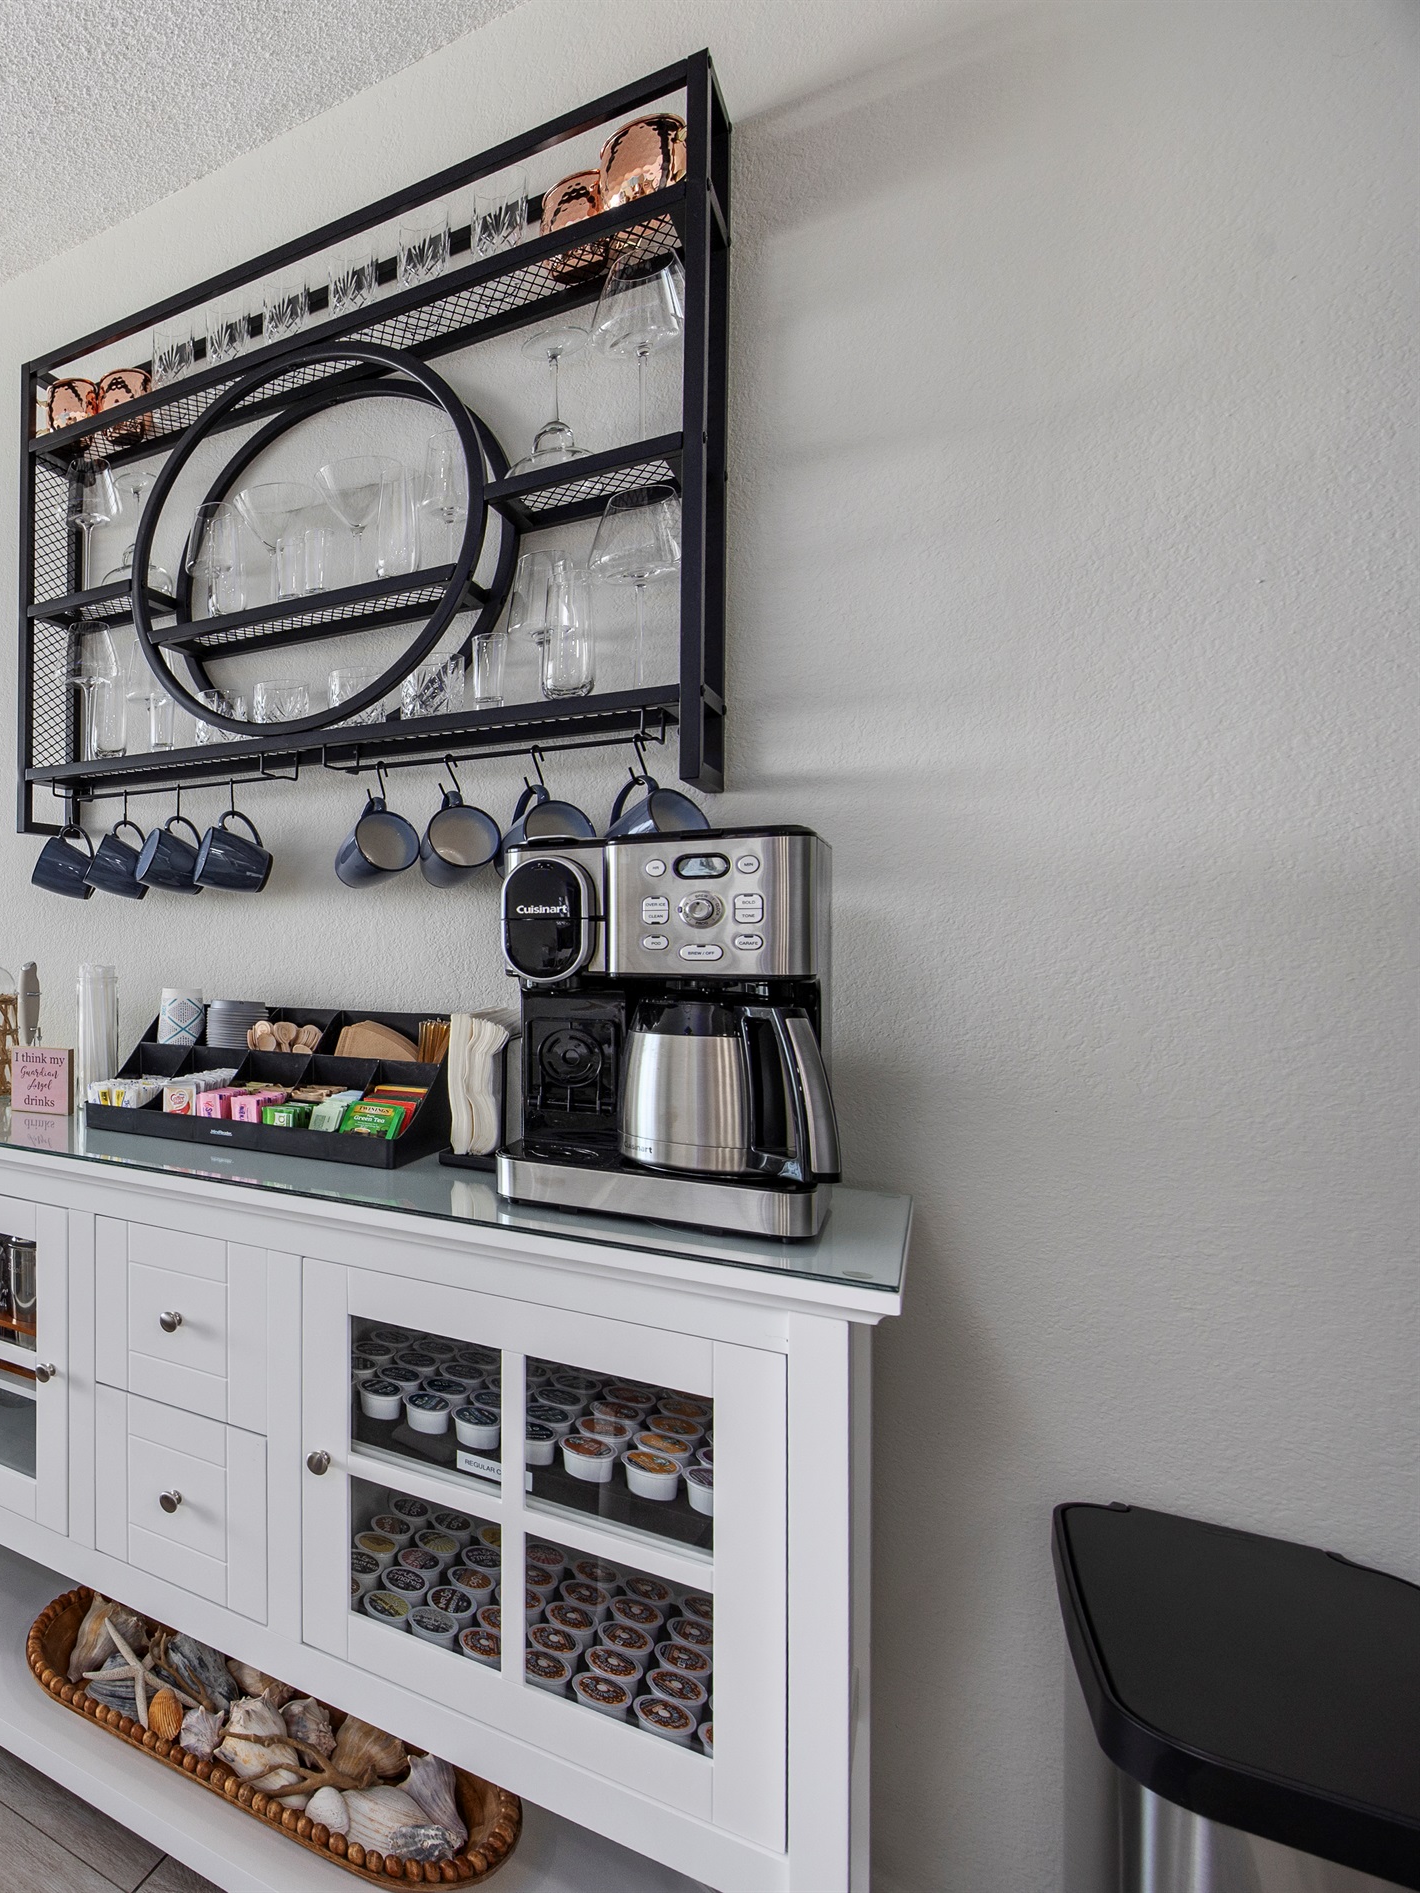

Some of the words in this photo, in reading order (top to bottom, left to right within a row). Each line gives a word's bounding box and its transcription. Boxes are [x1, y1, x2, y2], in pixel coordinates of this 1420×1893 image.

[516, 904, 568, 914] Cuisinart
[15, 1052, 19, 1062] I
[21, 1052, 47, 1064] think
[49, 1056, 65, 1067] my
[20, 1065, 58, 1079] Guardian
[27, 1078, 52, 1092] Angel
[24, 1094, 55, 1107] drinks
[359, 1105, 390, 1113] TWININGS
[464, 1459, 496, 1474] REGULAR
